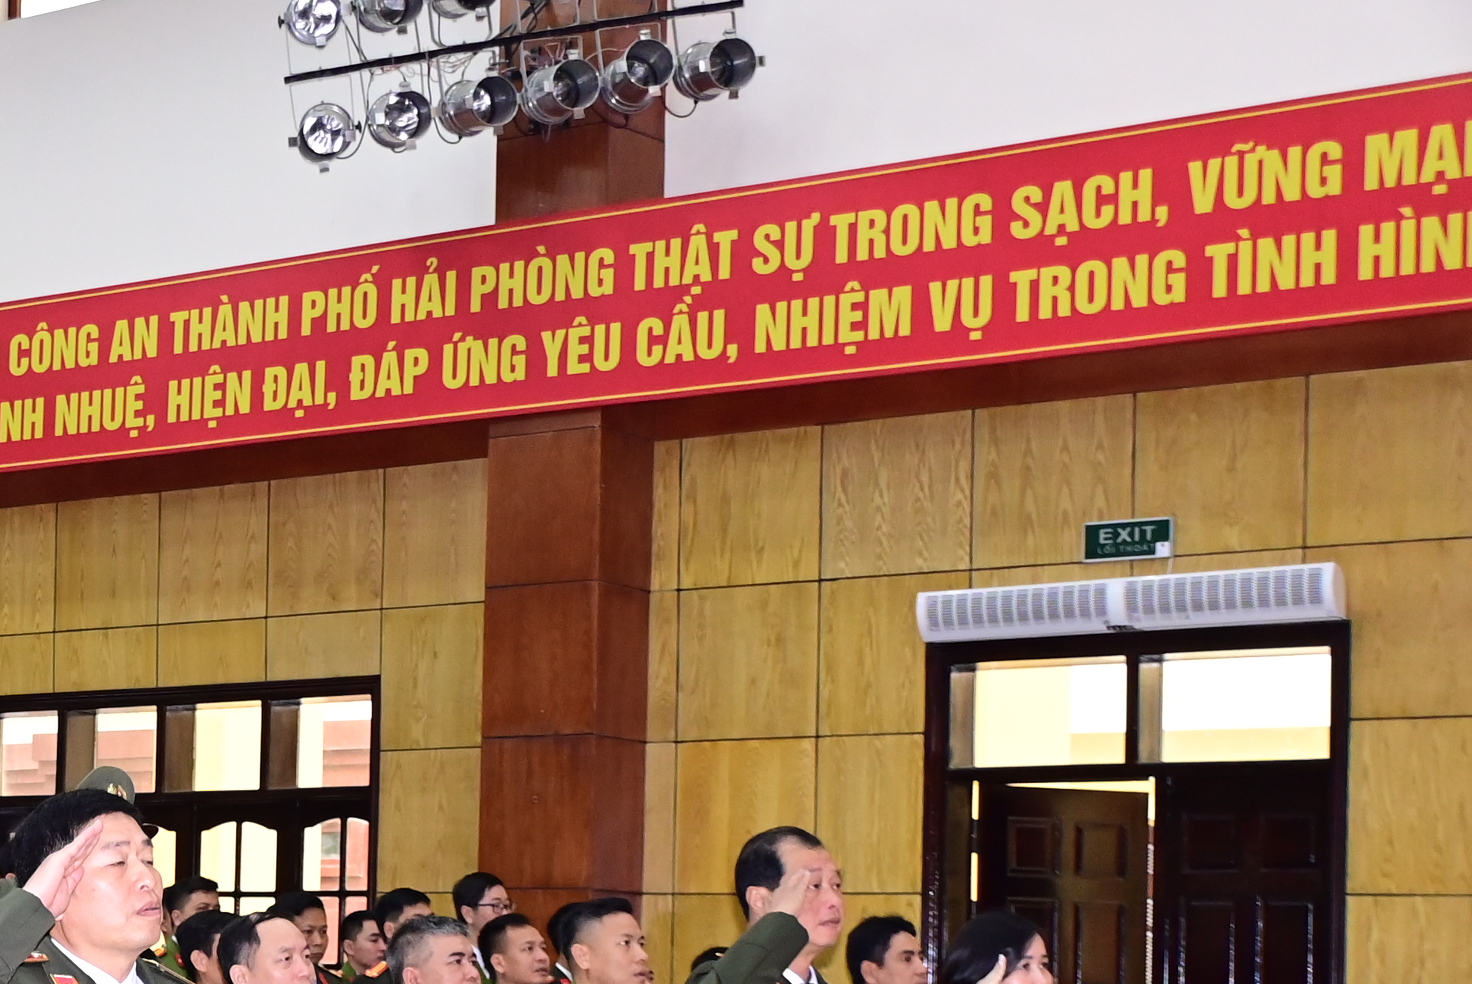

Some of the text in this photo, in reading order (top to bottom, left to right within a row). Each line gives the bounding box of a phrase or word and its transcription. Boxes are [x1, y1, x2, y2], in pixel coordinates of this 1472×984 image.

[9, 322, 99, 376] CÔNG
[110, 315, 159, 363] AN
[170, 294, 289, 354] THÀNH
[303, 265, 379, 336] PHỐ
[391, 256, 457, 323] HẢI
[471, 245, 616, 312] PHÒNG
[630, 223, 739, 295] THẬT
[753, 212, 821, 281] SỰ
[830, 193, 994, 263] TRONG
[1011, 168, 1168, 245] SẠCH,
[1189, 141, 1343, 214] VỮNG
[1365, 121, 1472, 194] MẠ
[55, 376, 155, 436] NHUỆ,
[168, 365, 253, 429] HIỆN
[263, 360, 337, 416] ĐẠI,
[350, 340, 430, 400] ĐÁP
[442, 323, 528, 389] ỨNG
[542, 316, 622, 377] YÊU
[637, 296, 738, 366] CẦU,
[756, 281, 913, 354] NHIỆM
[930, 275, 994, 340] VỤ
[1010, 250, 1187, 322] TRONG
[1206, 229, 1338, 298] TÌNH
[1359, 207, 1472, 280] HÌN
[1098, 525, 1157, 544] EXIT
